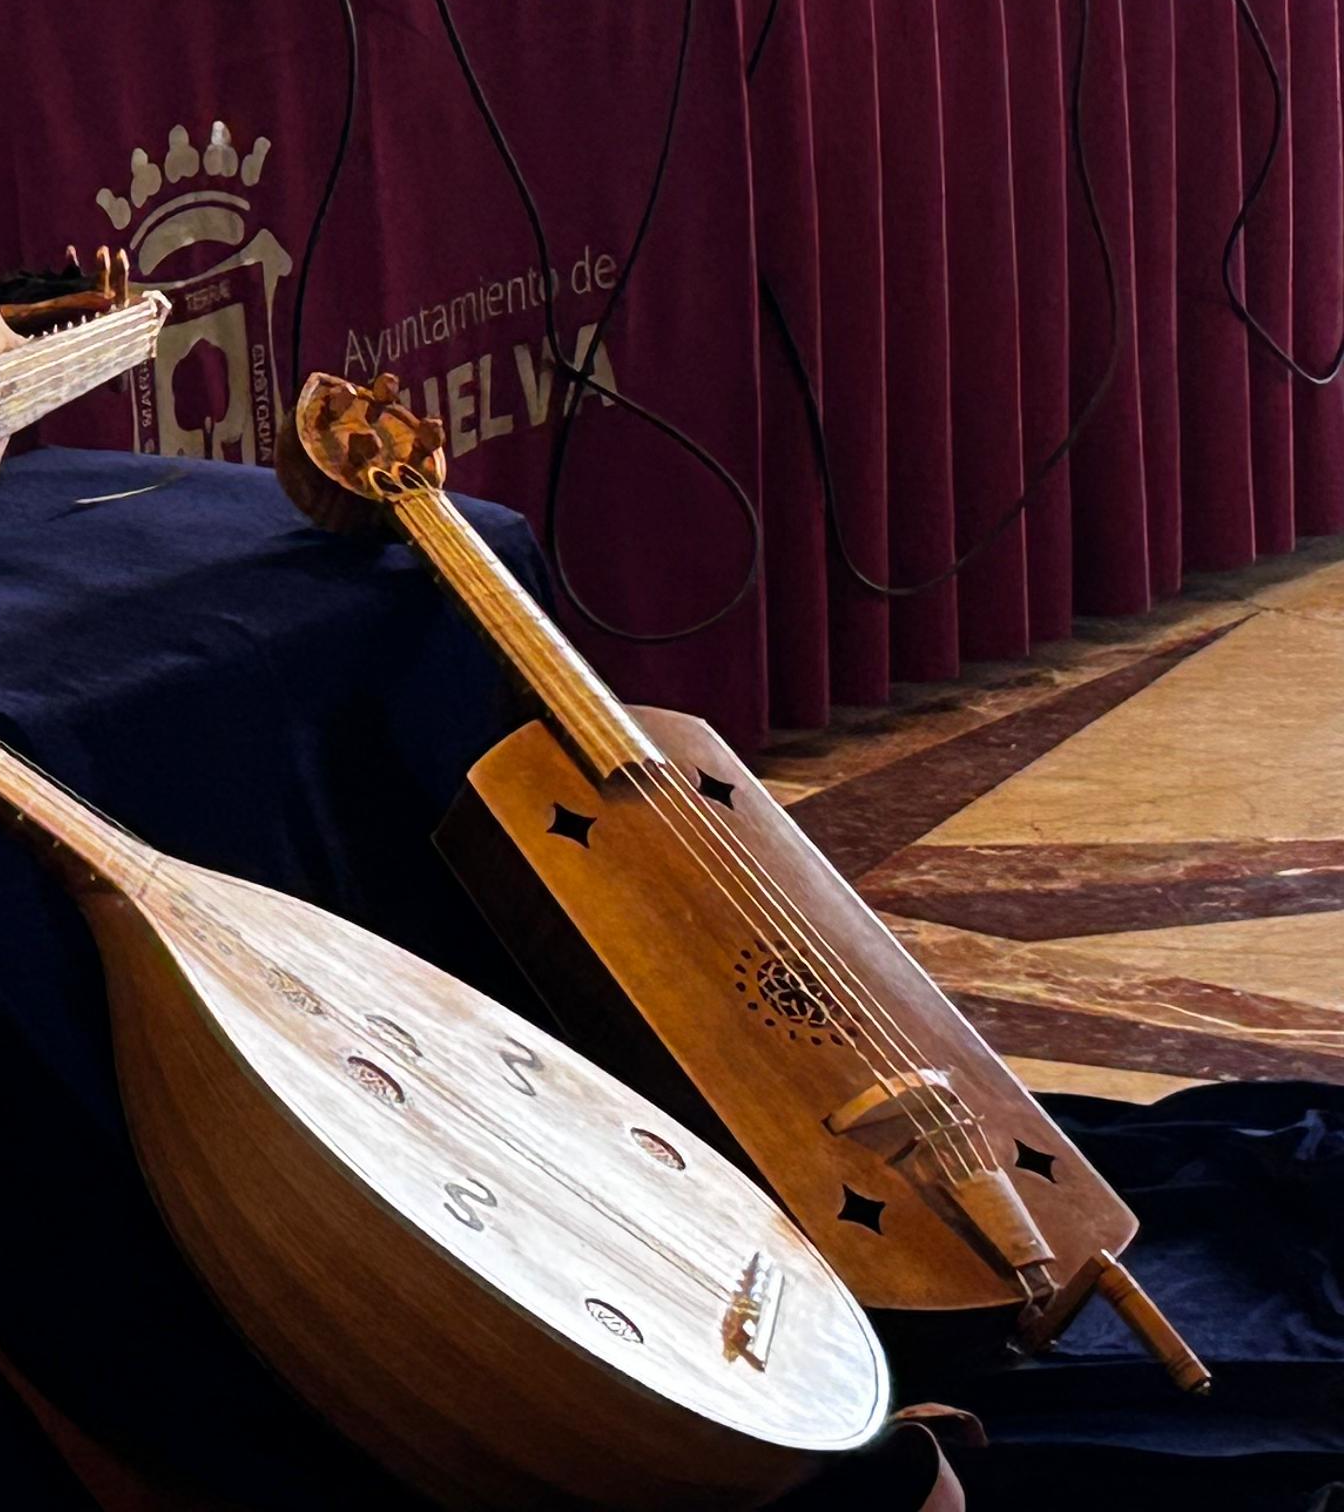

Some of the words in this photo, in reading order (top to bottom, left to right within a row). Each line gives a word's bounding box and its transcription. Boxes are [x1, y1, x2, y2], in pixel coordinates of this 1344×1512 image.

[343, 265, 559, 385] Ayuntamiento
[570, 245, 618, 296] de
[397, 321, 618, 459] UELVA
